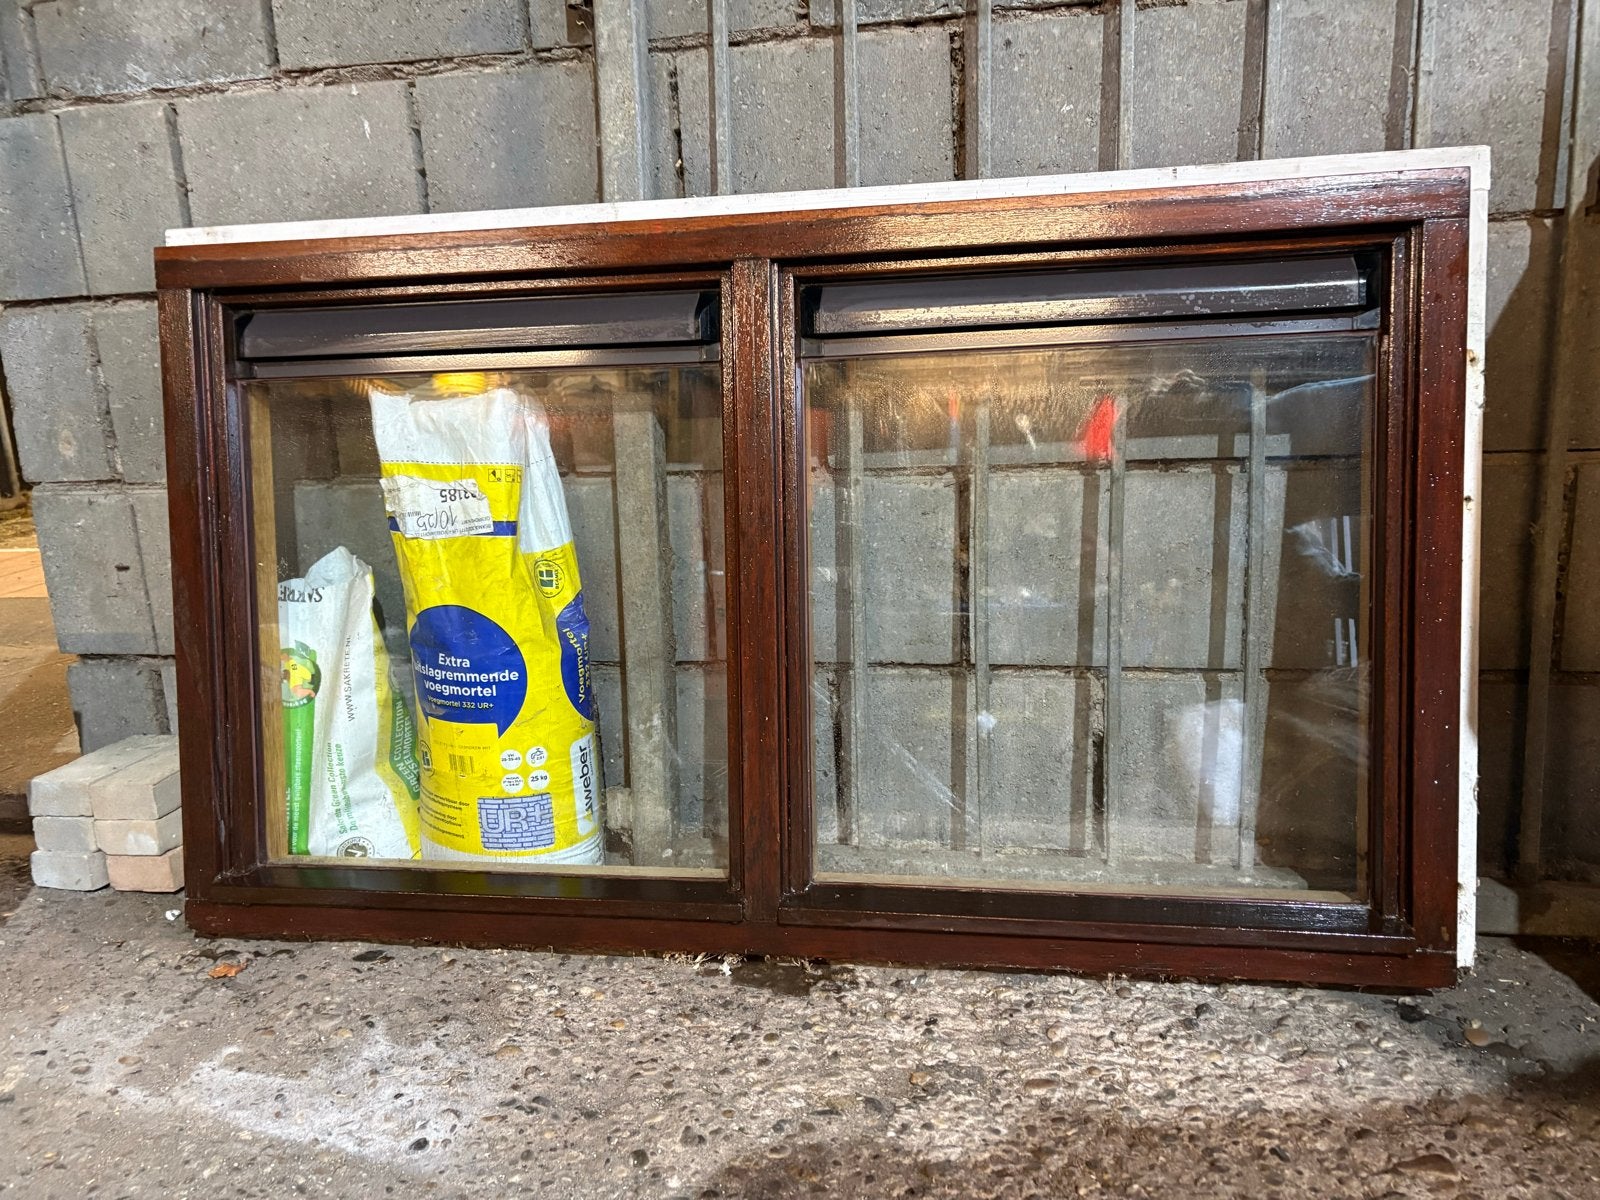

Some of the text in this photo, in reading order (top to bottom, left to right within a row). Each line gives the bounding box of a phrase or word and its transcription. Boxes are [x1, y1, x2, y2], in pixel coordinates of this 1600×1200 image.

[438, 653, 470, 668] Extra
[562, 627, 585, 704] Voegmortel
[424, 679, 497, 697] voegmortel
[427, 696, 461, 708] Voegmortel
[462, 701, 476, 709] 332
[393, 700, 420, 793] GREEN COLLECTION
[579, 745, 593, 807] weber
[330, 784, 340, 807] Green
[480, 803, 549, 834] UR+
